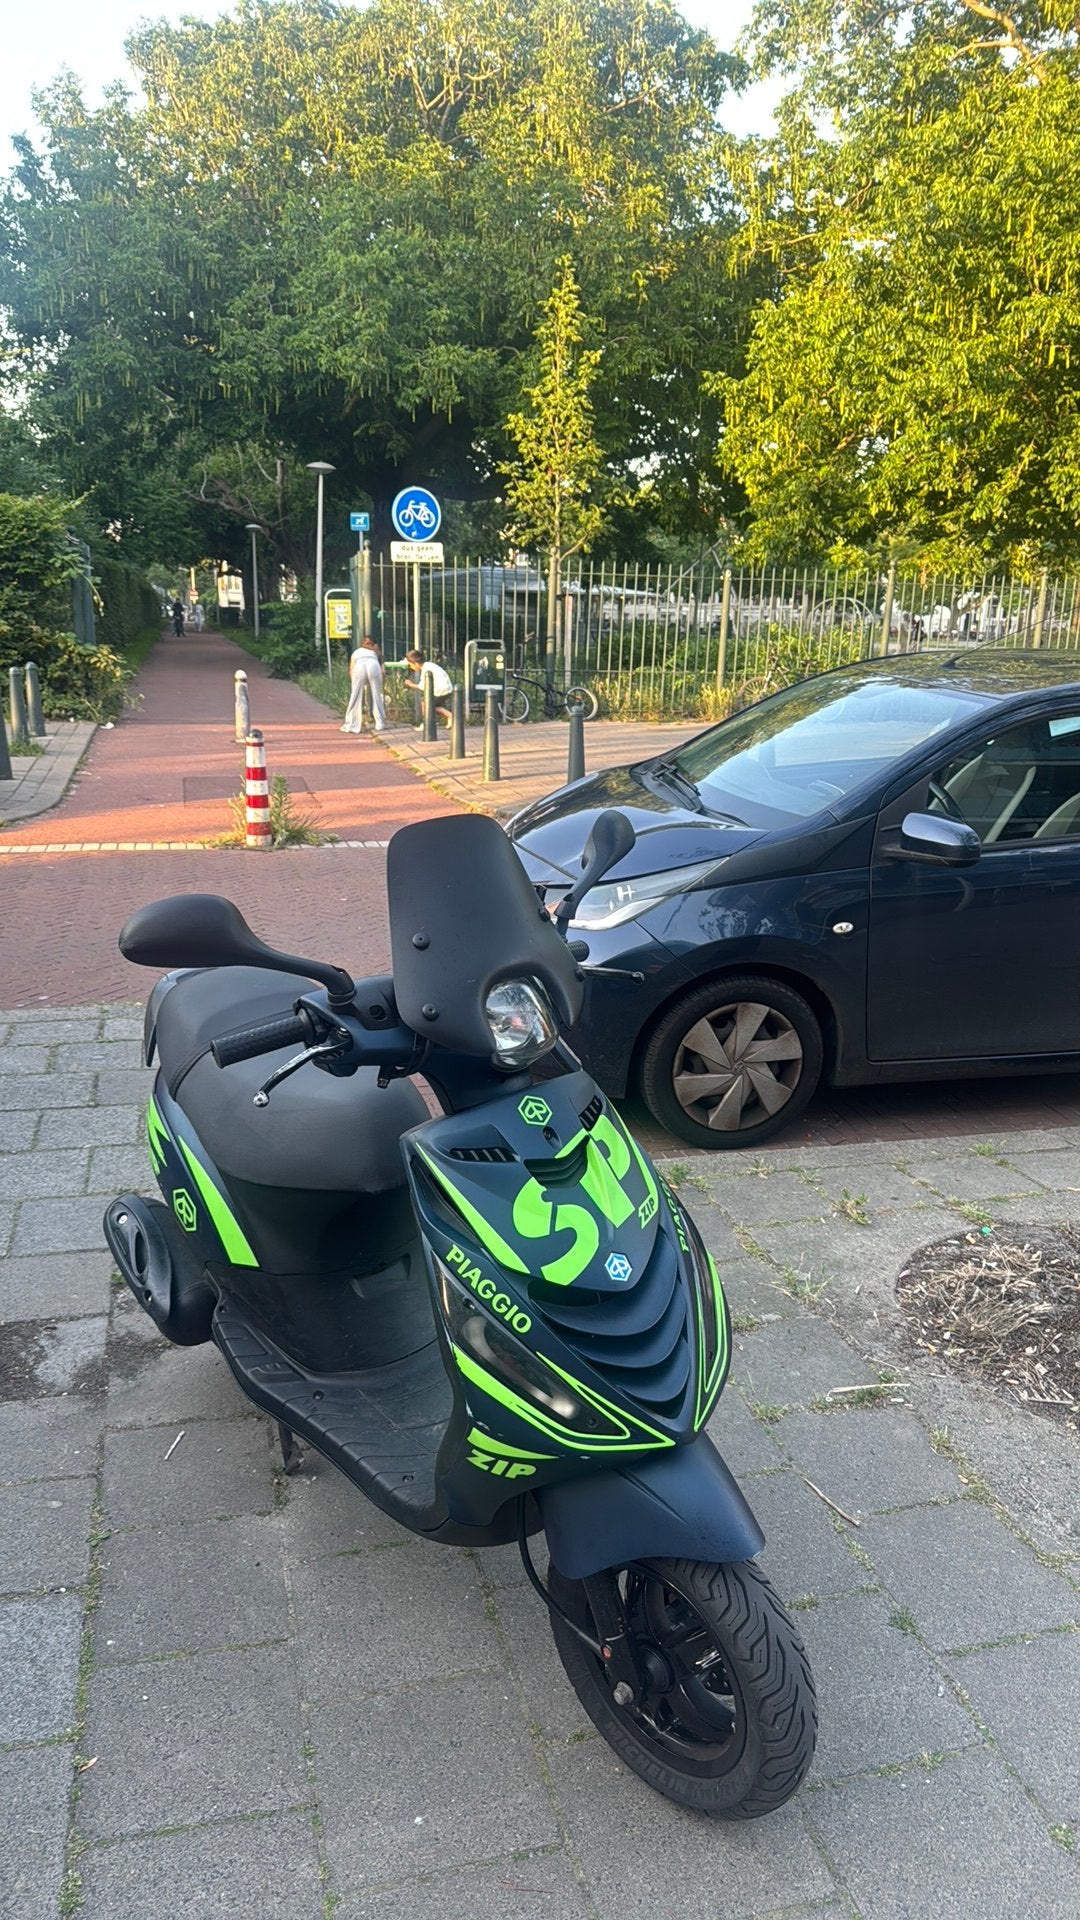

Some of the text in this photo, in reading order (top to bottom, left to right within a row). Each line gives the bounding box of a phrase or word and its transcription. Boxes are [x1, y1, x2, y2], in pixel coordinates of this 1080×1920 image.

[639, 1196, 656, 1224] ZIP
[445, 1244, 532, 1334] PIAGGIO
[465, 1449, 537, 1479] ZIP
